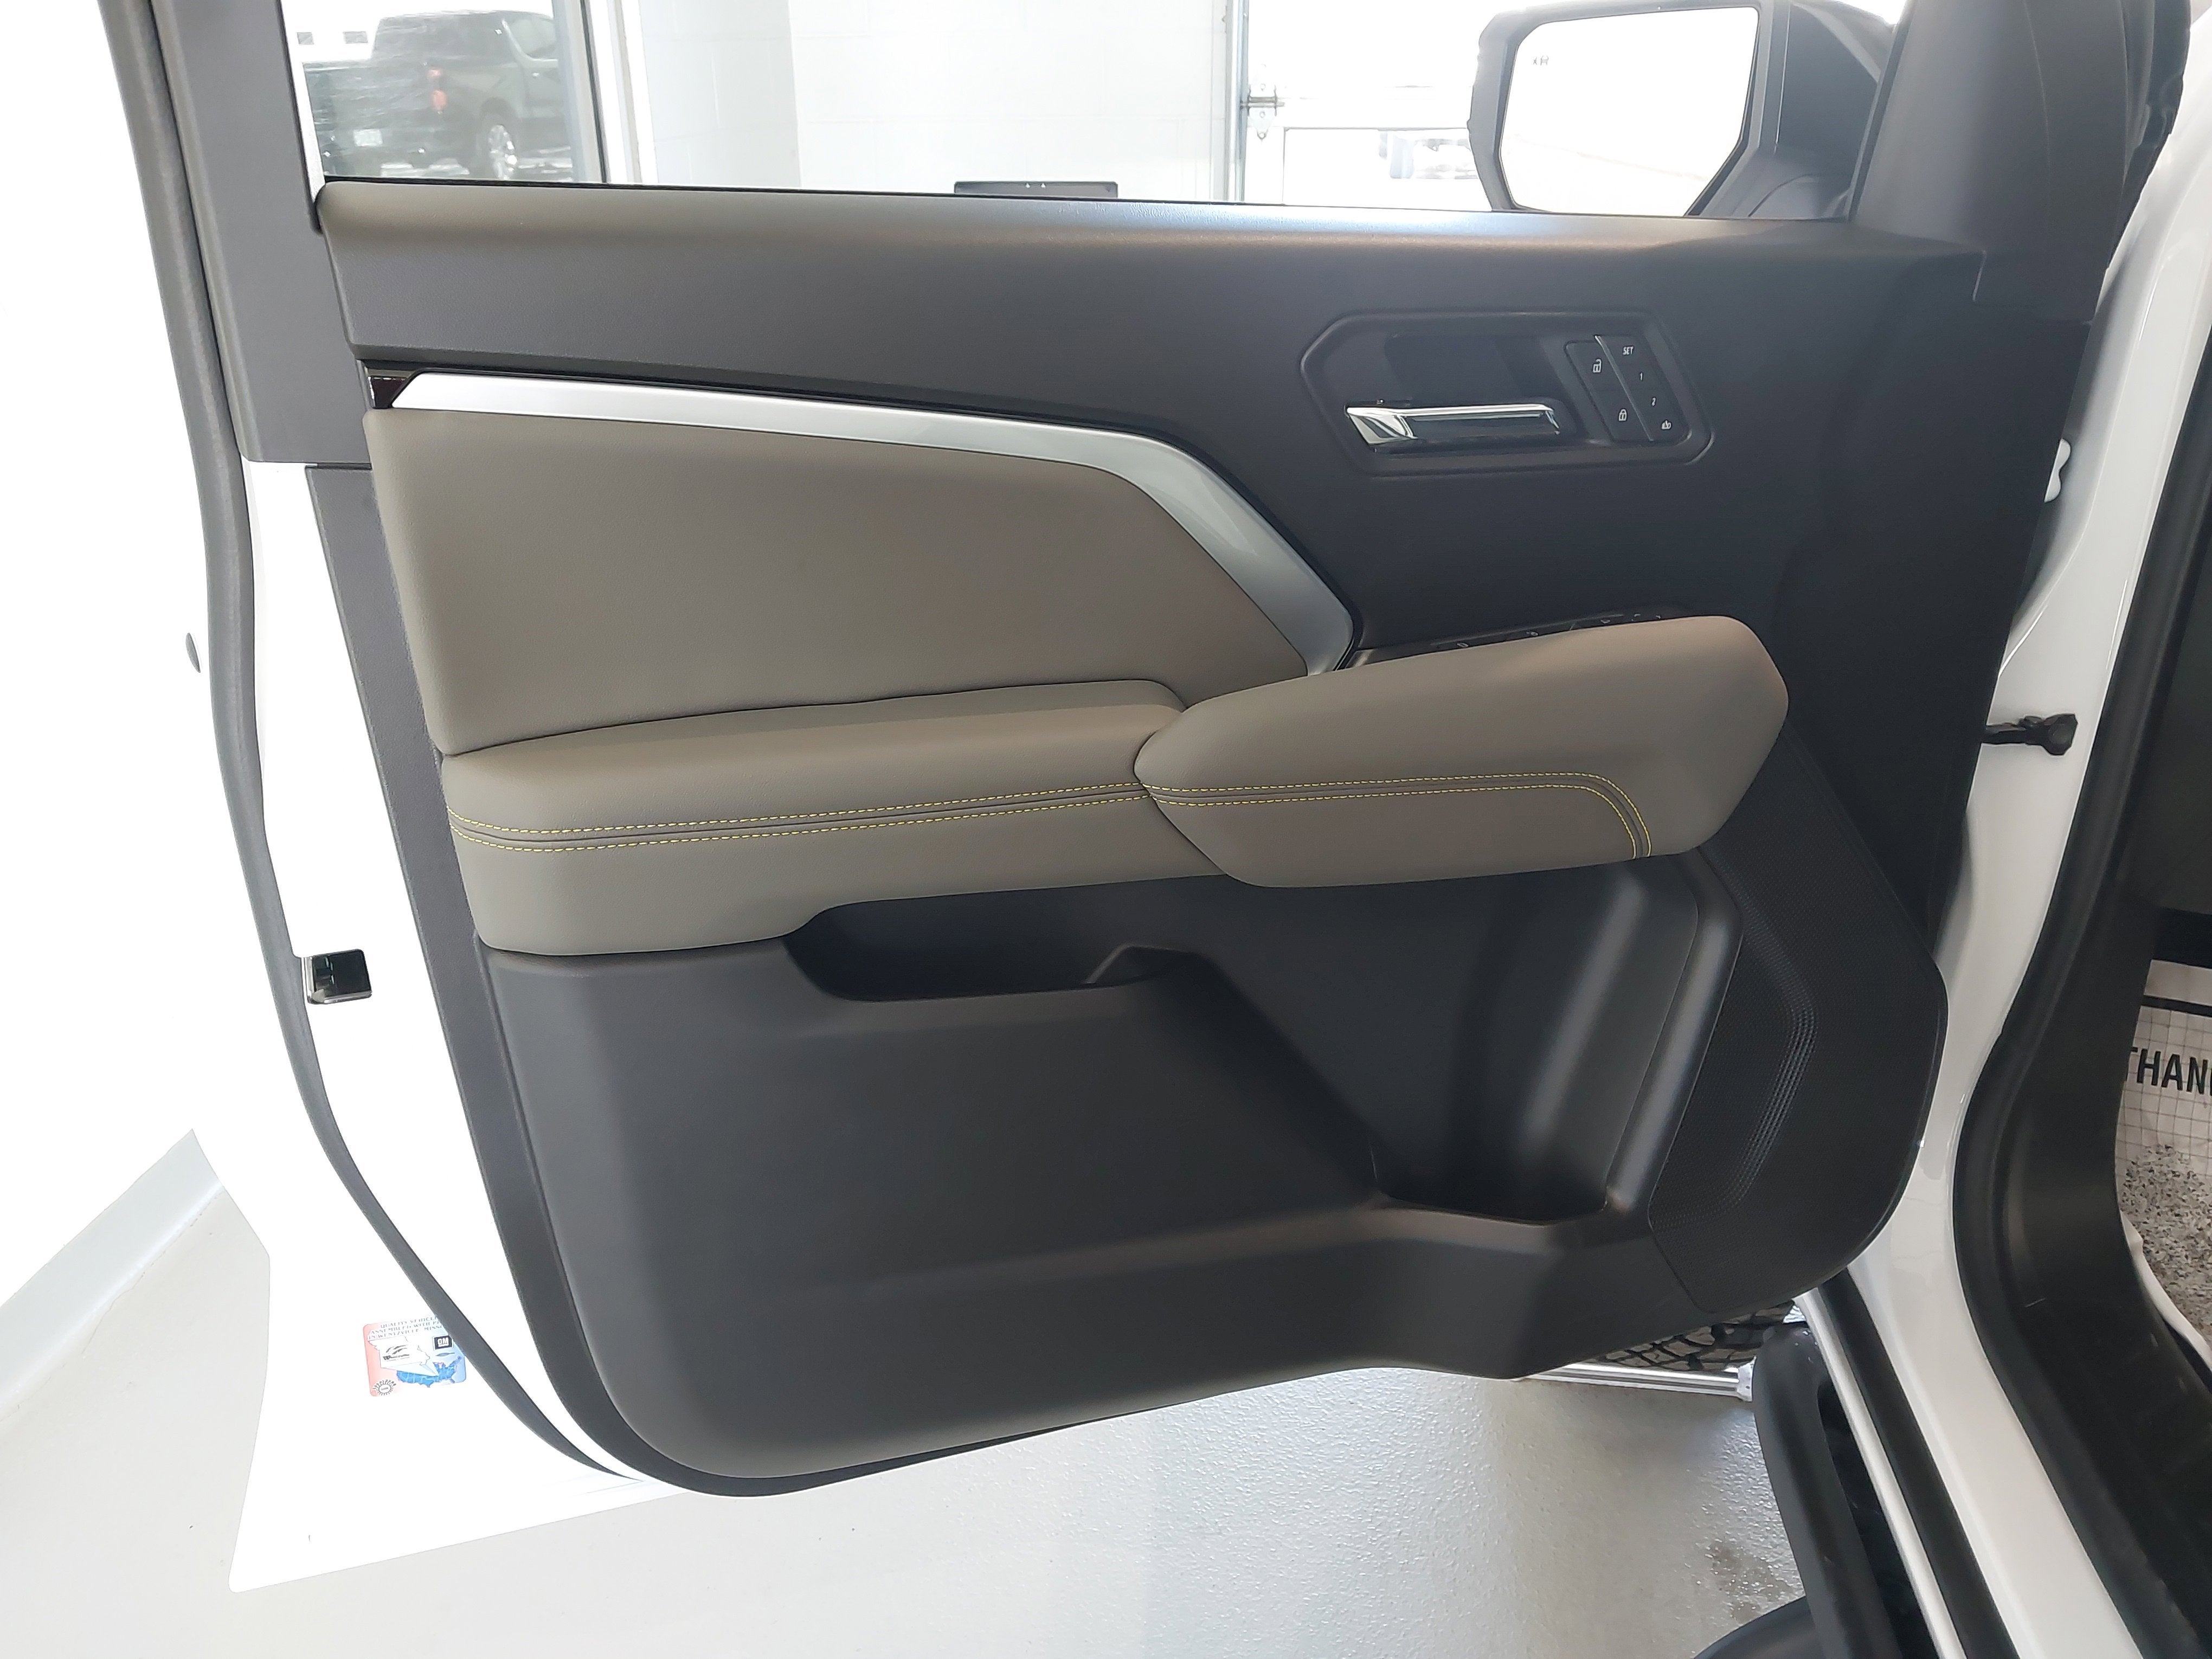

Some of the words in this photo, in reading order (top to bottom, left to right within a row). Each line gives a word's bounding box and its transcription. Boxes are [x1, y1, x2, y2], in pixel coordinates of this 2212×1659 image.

[1623, 346, 1634, 355] SET
[1640, 372, 1643, 381] 1
[1652, 397, 1656, 406] 2
